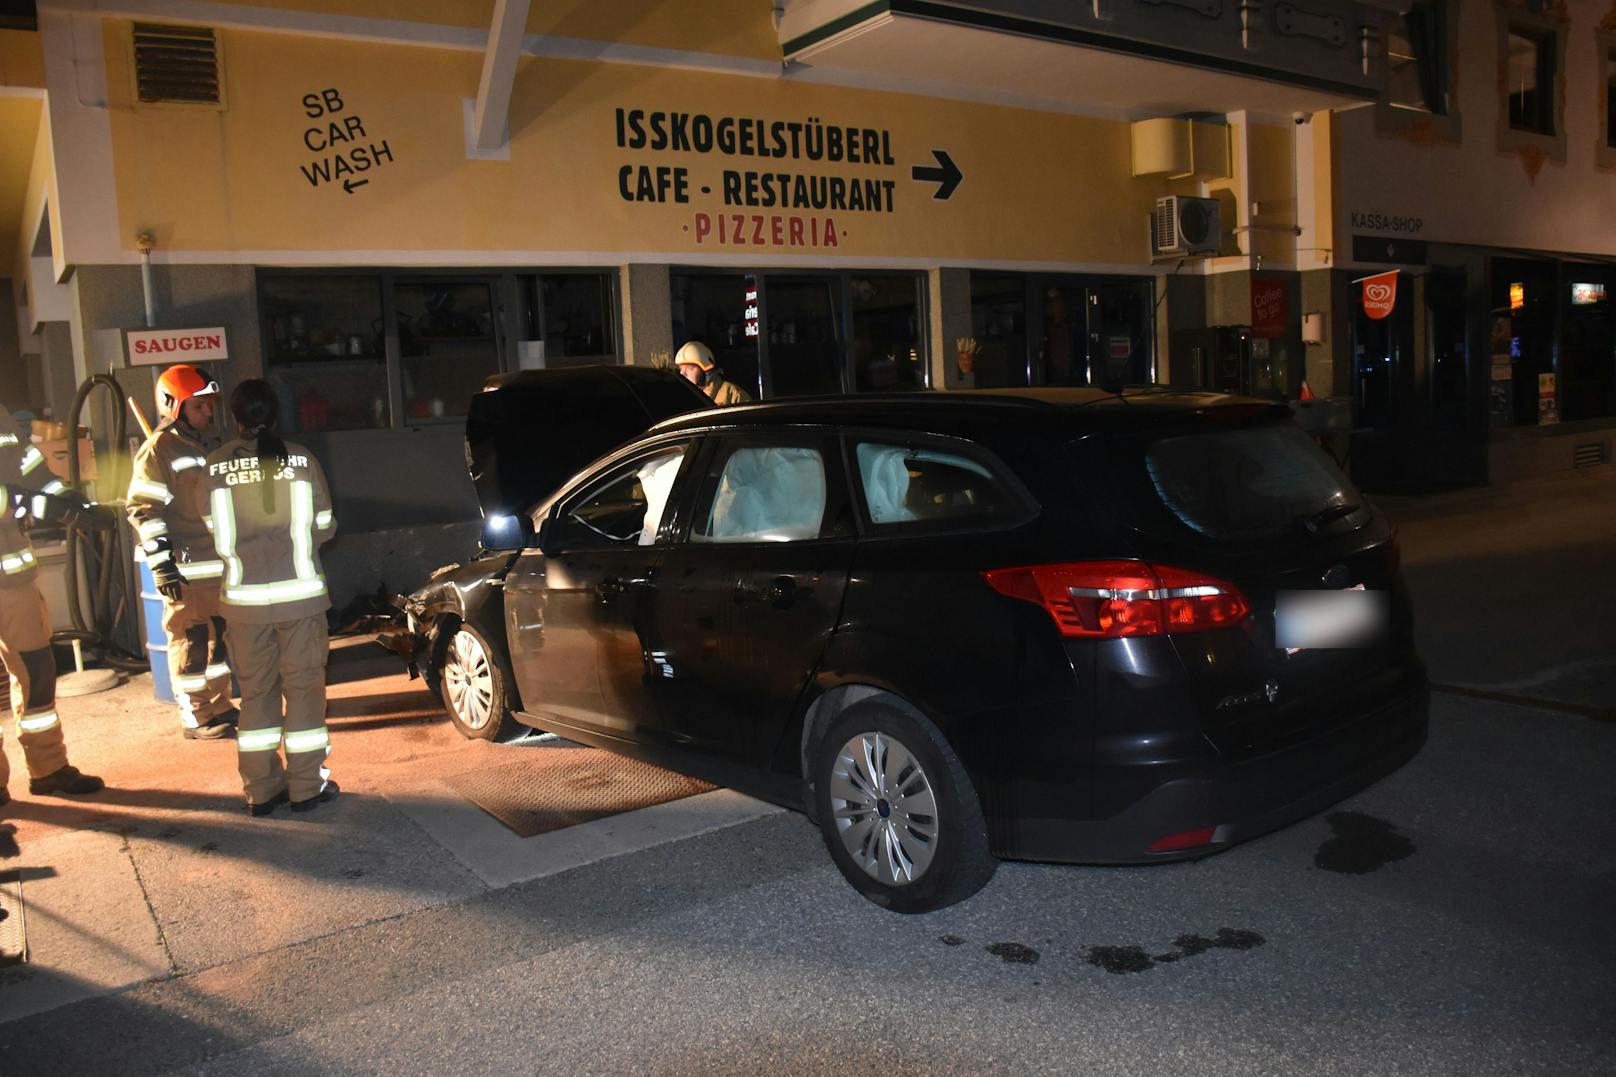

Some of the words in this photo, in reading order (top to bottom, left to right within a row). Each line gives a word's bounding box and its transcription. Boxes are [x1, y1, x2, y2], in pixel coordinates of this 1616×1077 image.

[302, 88, 344, 118] SB
[304, 116, 366, 151] CAR
[615, 108, 895, 165] ISSKOGELSTÜBERL
[300, 140, 394, 187] WASH
[618, 165, 689, 203] CAFE
[723, 170, 895, 213] RESTAURANT
[135, 335, 221, 354] SAUGEN
[209, 455, 308, 477] FEUERHR
